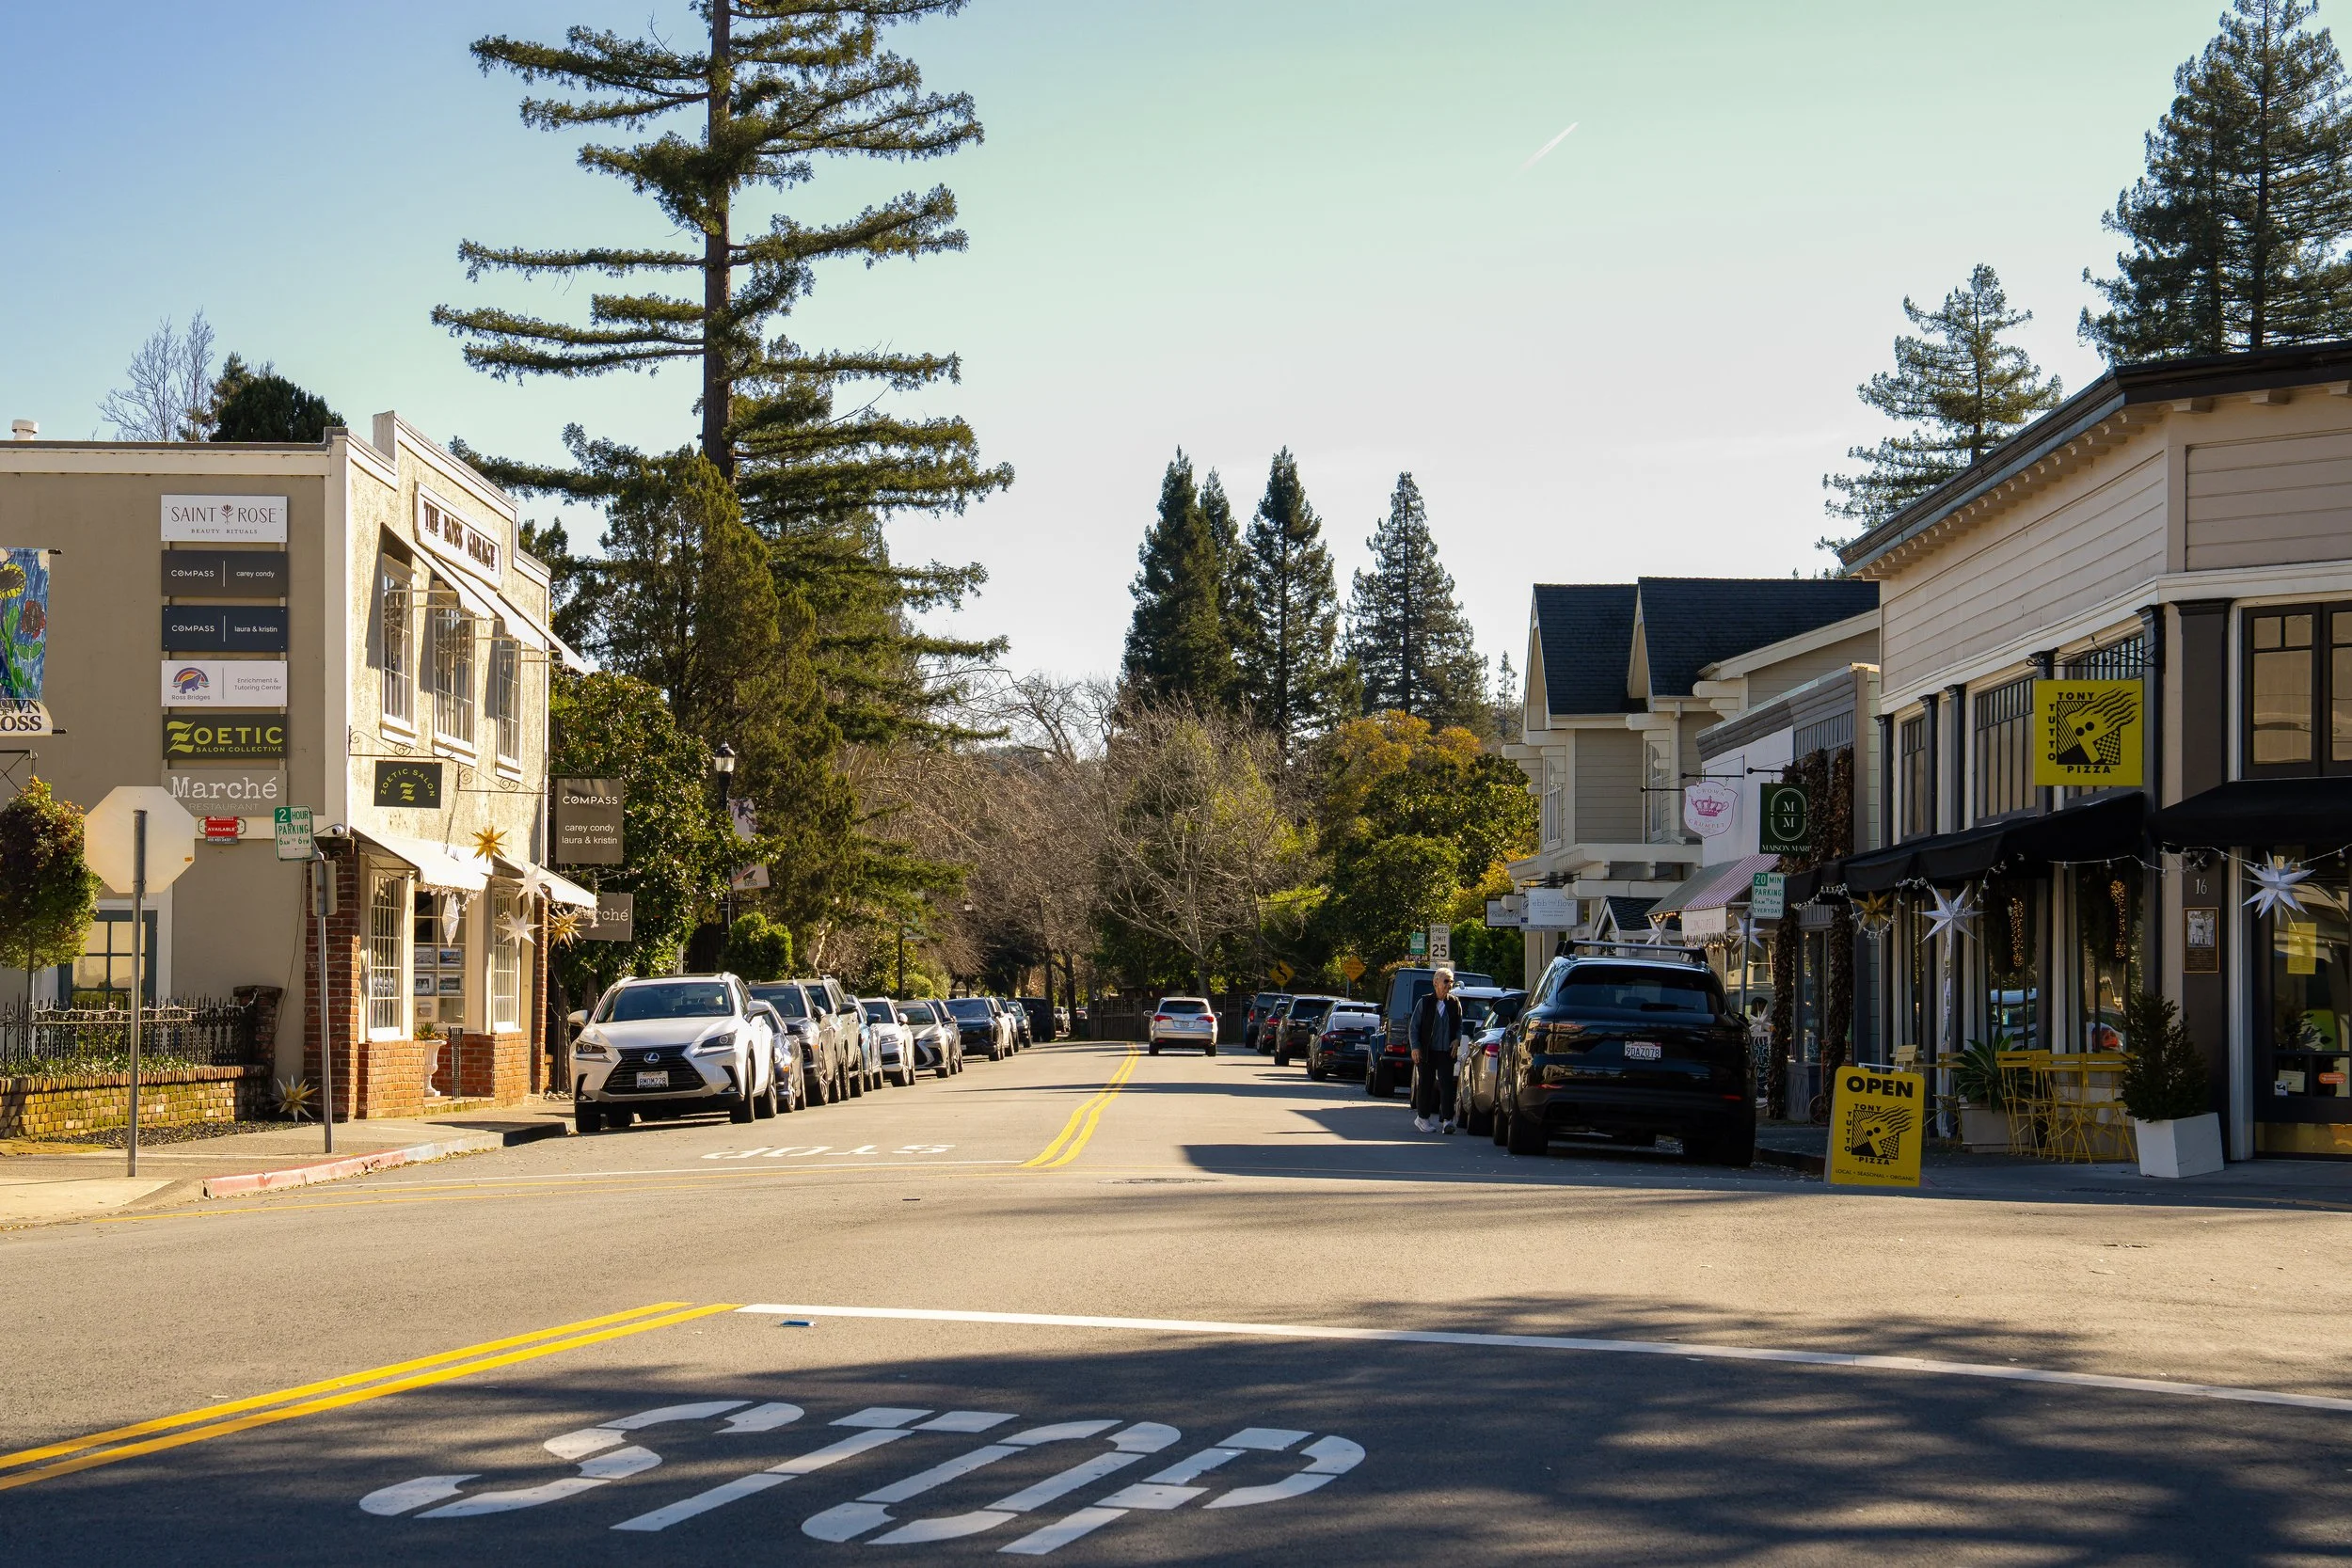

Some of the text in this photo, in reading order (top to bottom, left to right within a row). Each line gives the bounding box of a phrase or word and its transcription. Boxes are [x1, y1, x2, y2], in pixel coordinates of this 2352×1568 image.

[171, 506, 277, 523] SAINT ROSE
[423, 499, 496, 569] THE ROSS GARAGE
[170, 569, 215, 578] COMPASS
[255, 570, 275, 578] condy
[0, 698, 40, 714] OWN
[0, 715, 42, 731] OSS
[167, 721, 283, 752] ZOETIC
[2047, 704, 2056, 761] TUTTO
[2067, 765, 2111, 773] PIZZA
[169, 776, 278, 800] Marché
[380, 768, 435, 797] ZOETIC SALON
[188, 802, 260, 811] RESTAURANT
[563, 796, 618, 804] COMPASS
[1783, 801, 1795, 812] M
[278, 808, 309, 821] 2 HOUR
[278, 824, 309, 835] PARKING
[590, 824, 615, 832] condy
[1783, 817, 1795, 828] M
[1756, 874, 1782, 884] 20 MIN
[2195, 878, 2208, 895] 16
[1755, 888, 1782, 896] PARKING
[1432, 943, 1447, 958] 25
[1846, 1075, 1914, 1099] OPEN
[1844, 1111, 1852, 1152] TUTTO
[701, 1144, 957, 1159] STOP
[1858, 1156, 1890, 1165] PIZZA
[358, 1400, 1366, 1555] STOP
